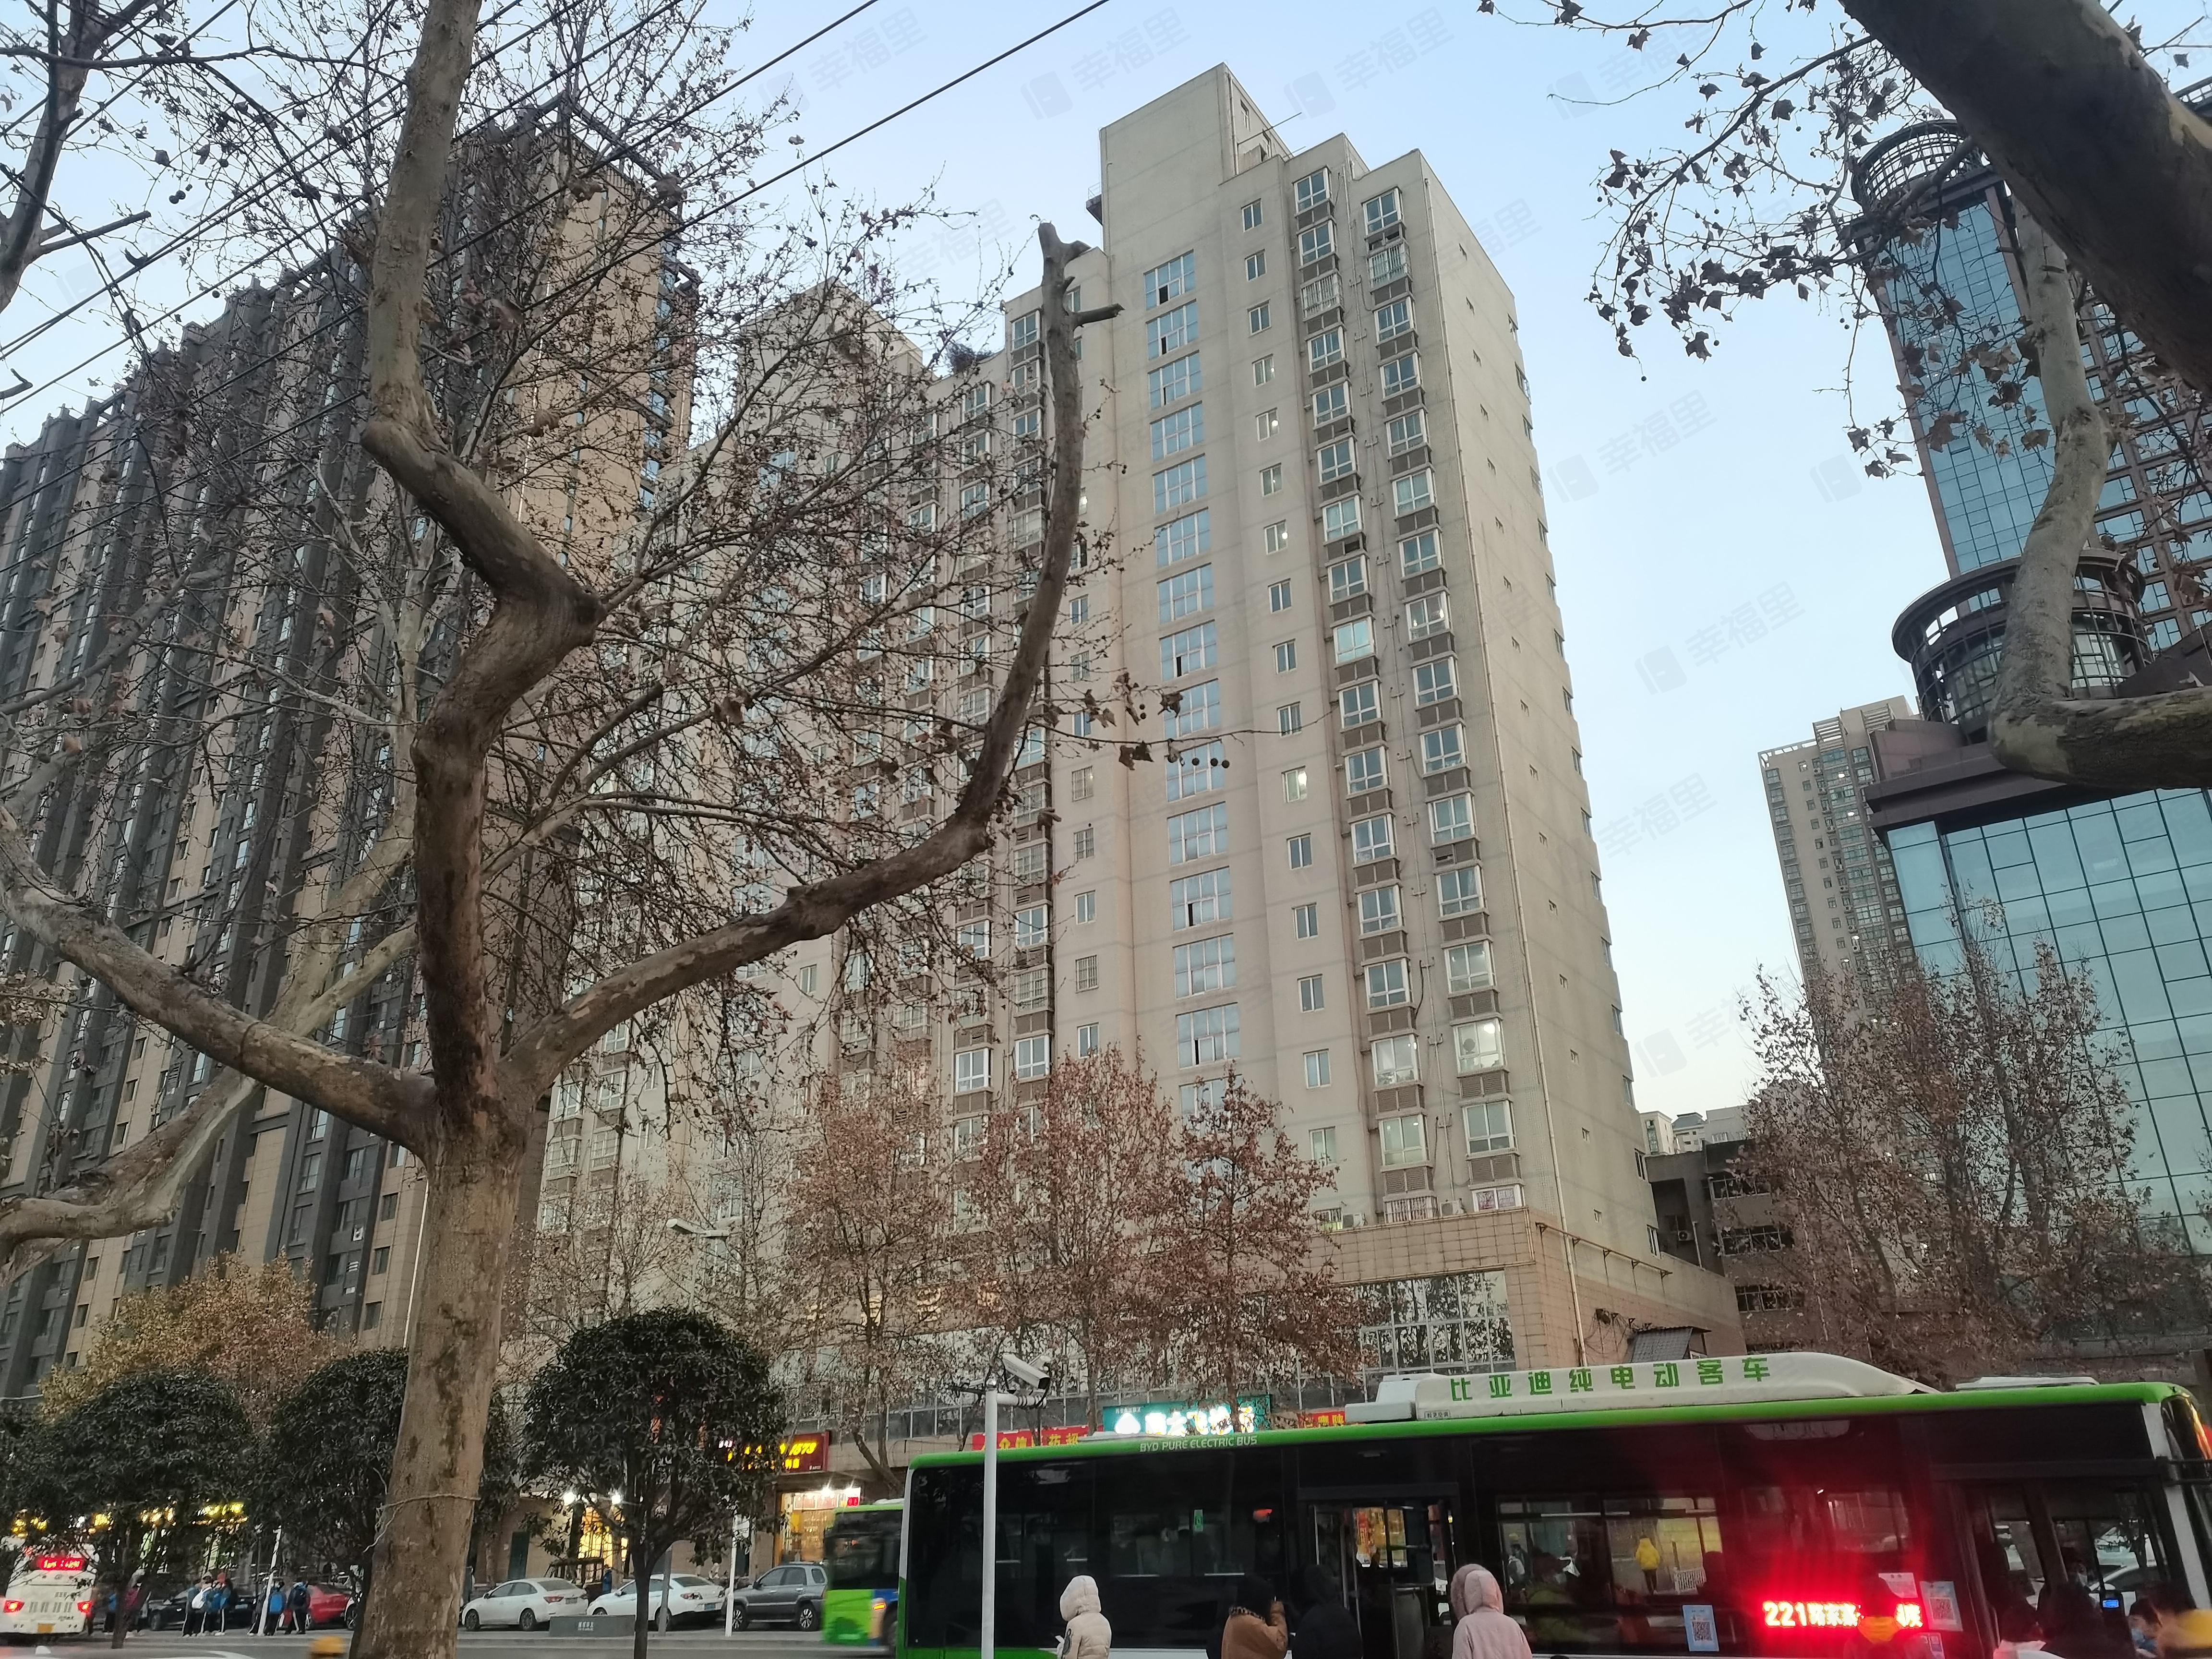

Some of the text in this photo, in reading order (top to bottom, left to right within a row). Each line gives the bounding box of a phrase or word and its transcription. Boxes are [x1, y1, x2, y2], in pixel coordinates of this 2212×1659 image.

[1450, 1357, 1770, 1401] 比亚迪纯电动客车
[1140, 1435, 1258, 1452] BYD PURE ELECTRIC BUS
